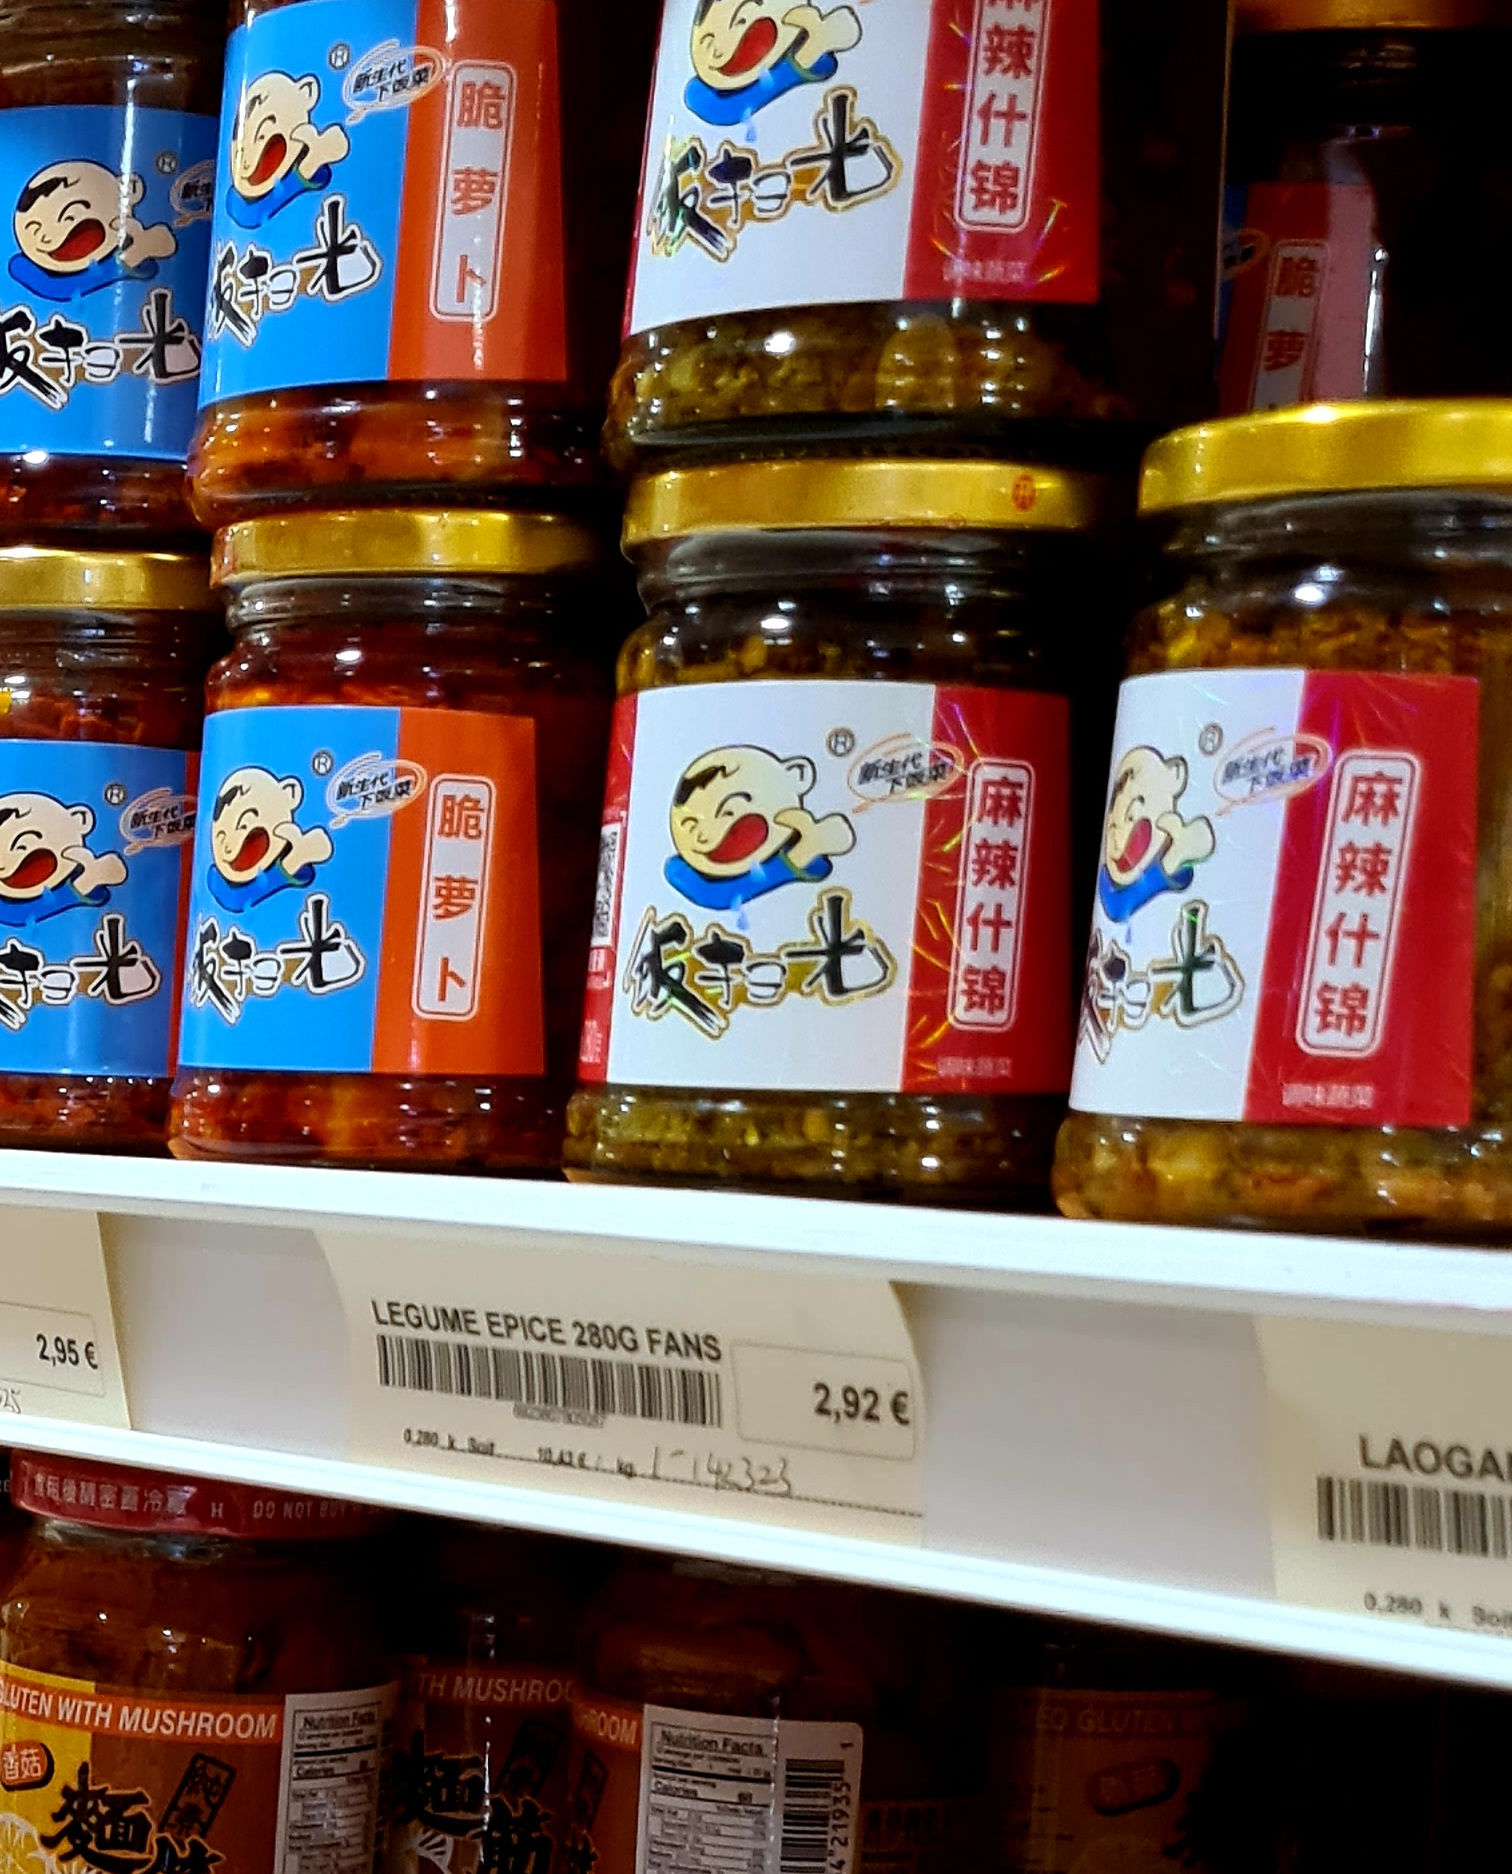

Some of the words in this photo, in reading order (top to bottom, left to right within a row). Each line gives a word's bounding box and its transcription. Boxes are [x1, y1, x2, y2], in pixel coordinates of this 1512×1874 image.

[433, 794, 484, 1002] 脆萝卜
[962, 776, 1025, 1017] 麻辣什锦
[1314, 771, 1402, 1037] 麻辣什锦
[36, 1333, 79, 1367] 2,95
[371, 1300, 482, 1338] LEGUME
[485, 1311, 566, 1345] EPICE
[571, 1320, 640, 1353] 280G
[644, 1328, 723, 1364] FANS
[812, 1381, 882, 1423] 2,92
[56, 1697, 111, 1729] WITH
[117, 1710, 278, 1740] MUSHROOM
[1, 1746, 44, 1782] 香菇
